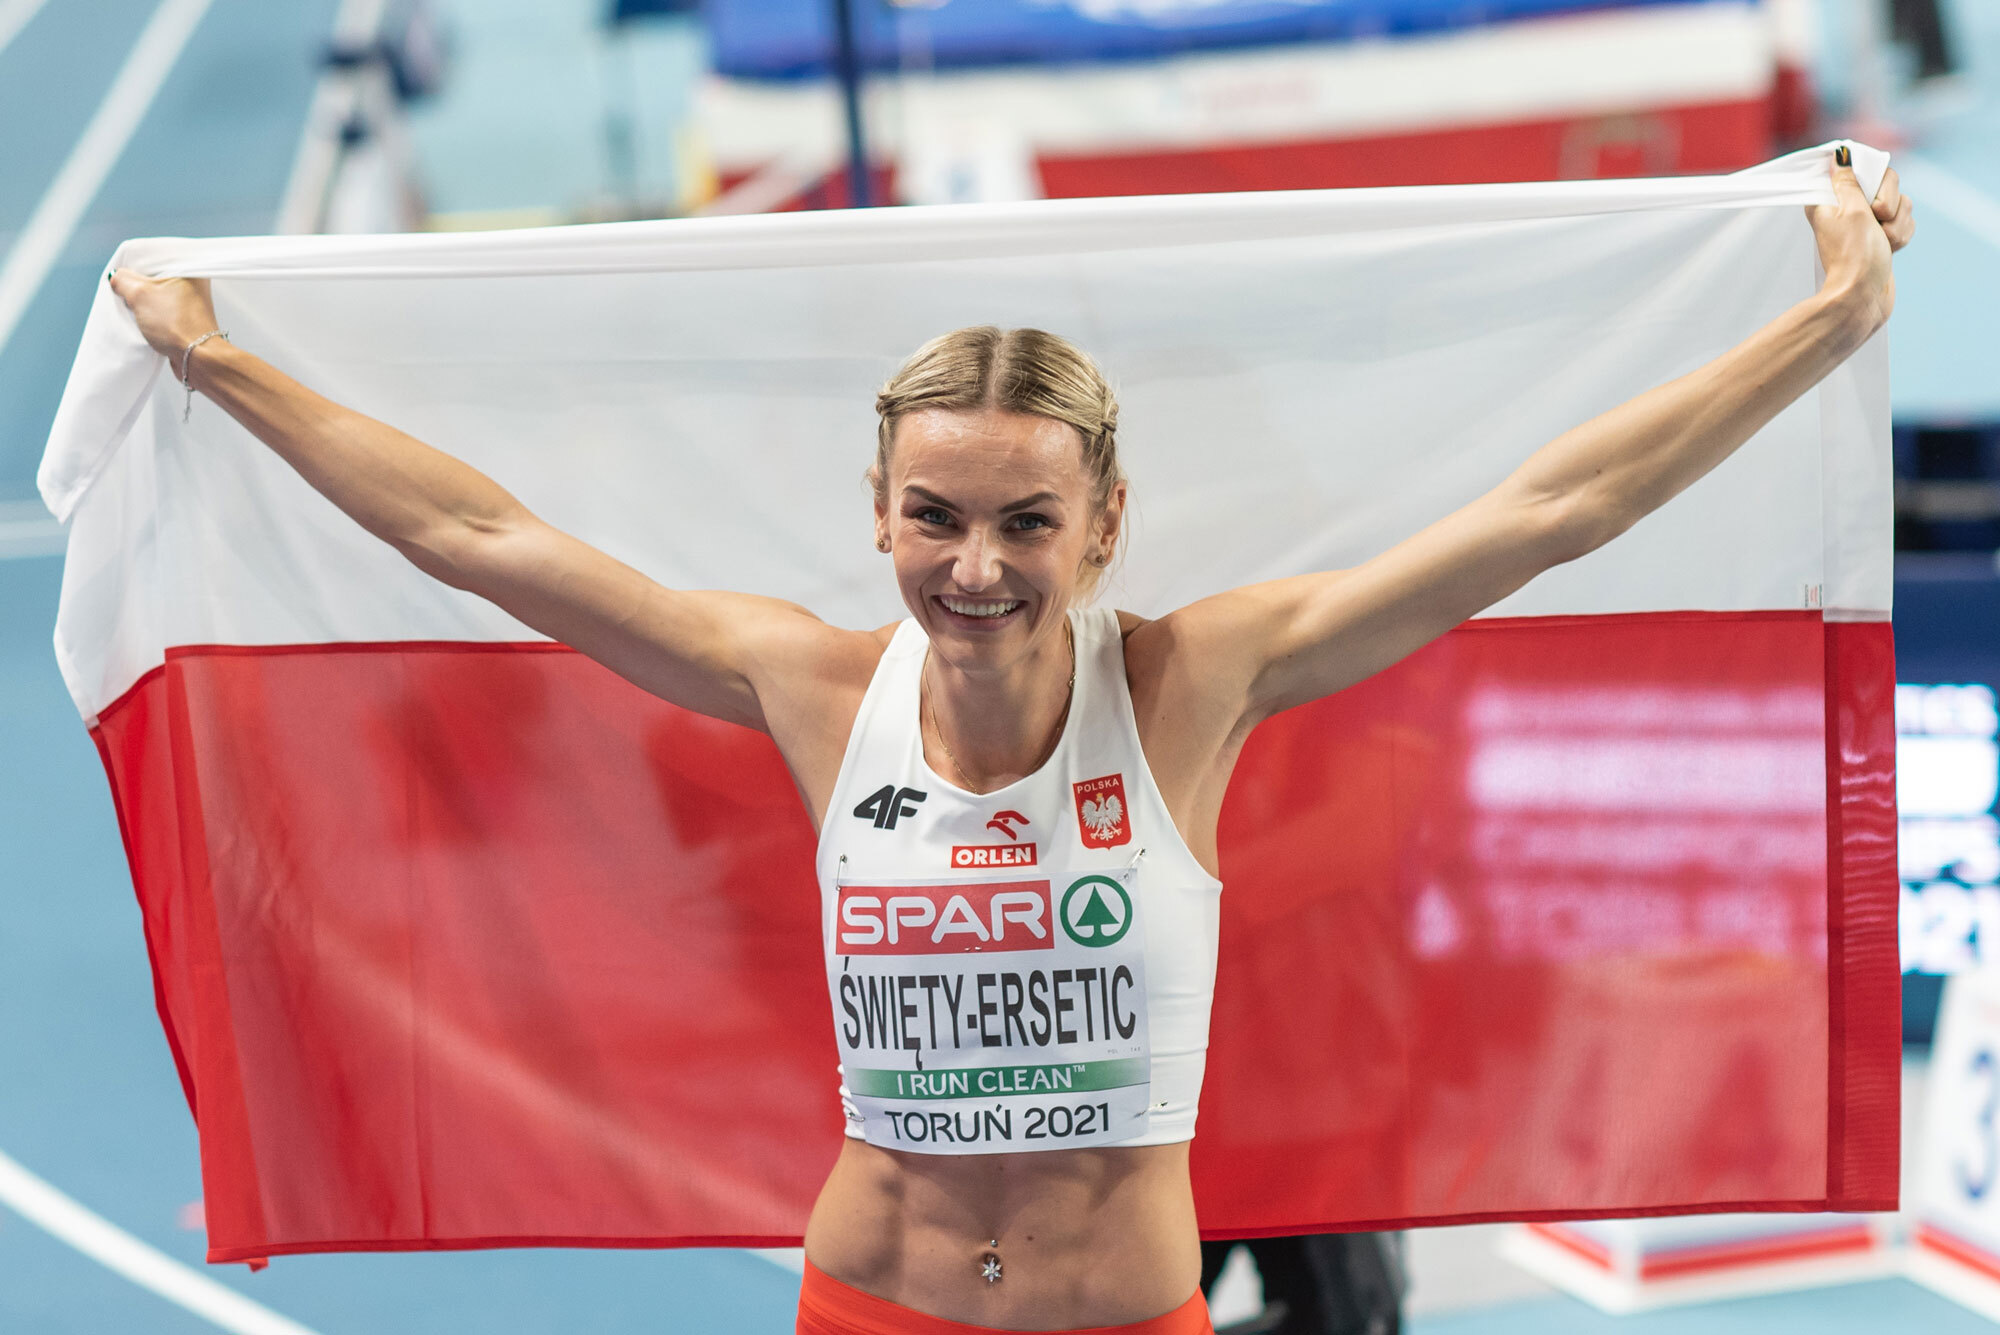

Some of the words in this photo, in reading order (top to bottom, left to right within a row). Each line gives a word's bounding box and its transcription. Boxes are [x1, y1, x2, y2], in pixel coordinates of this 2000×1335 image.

[1077, 778, 1120, 794] POLSKA
[853, 785, 927, 830] 4F
[956, 847, 1032, 866] ORLEN
[841, 891, 1047, 945] SPAR
[839, 956, 1137, 1071] ŚWIĘTY-ERSETIC
[897, 1073, 904, 1095] I
[910, 1072, 969, 1096] RUN
[884, 1104, 1012, 1143] TORUŃ
[1023, 1102, 1109, 1140] 2021
